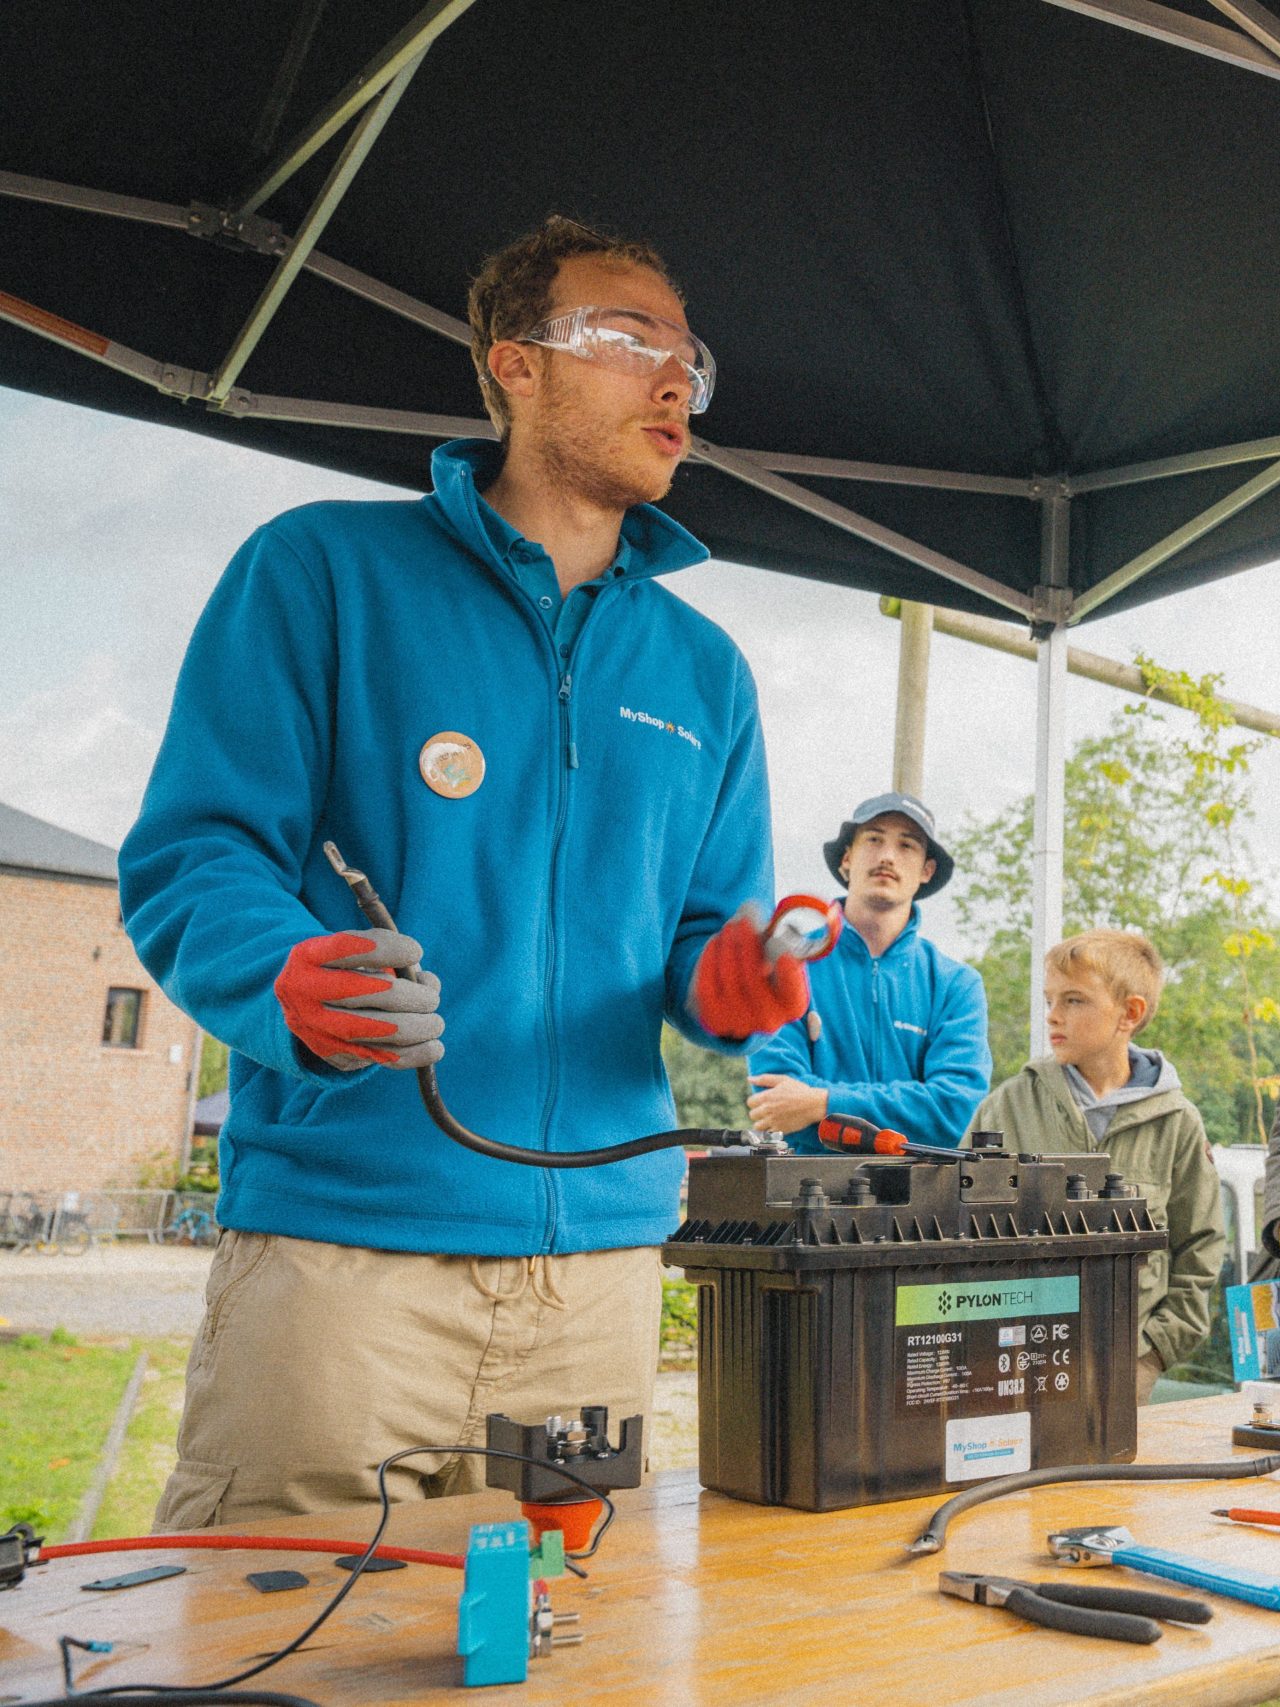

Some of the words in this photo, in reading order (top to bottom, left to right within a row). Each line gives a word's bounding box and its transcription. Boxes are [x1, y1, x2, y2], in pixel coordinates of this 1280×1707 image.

[620, 706, 665, 730] MyShop
[956, 1291, 1033, 1308] PYLONTECH
[907, 1332, 962, 1347] RT12100G31
[953, 1442, 987, 1452] MyShop
